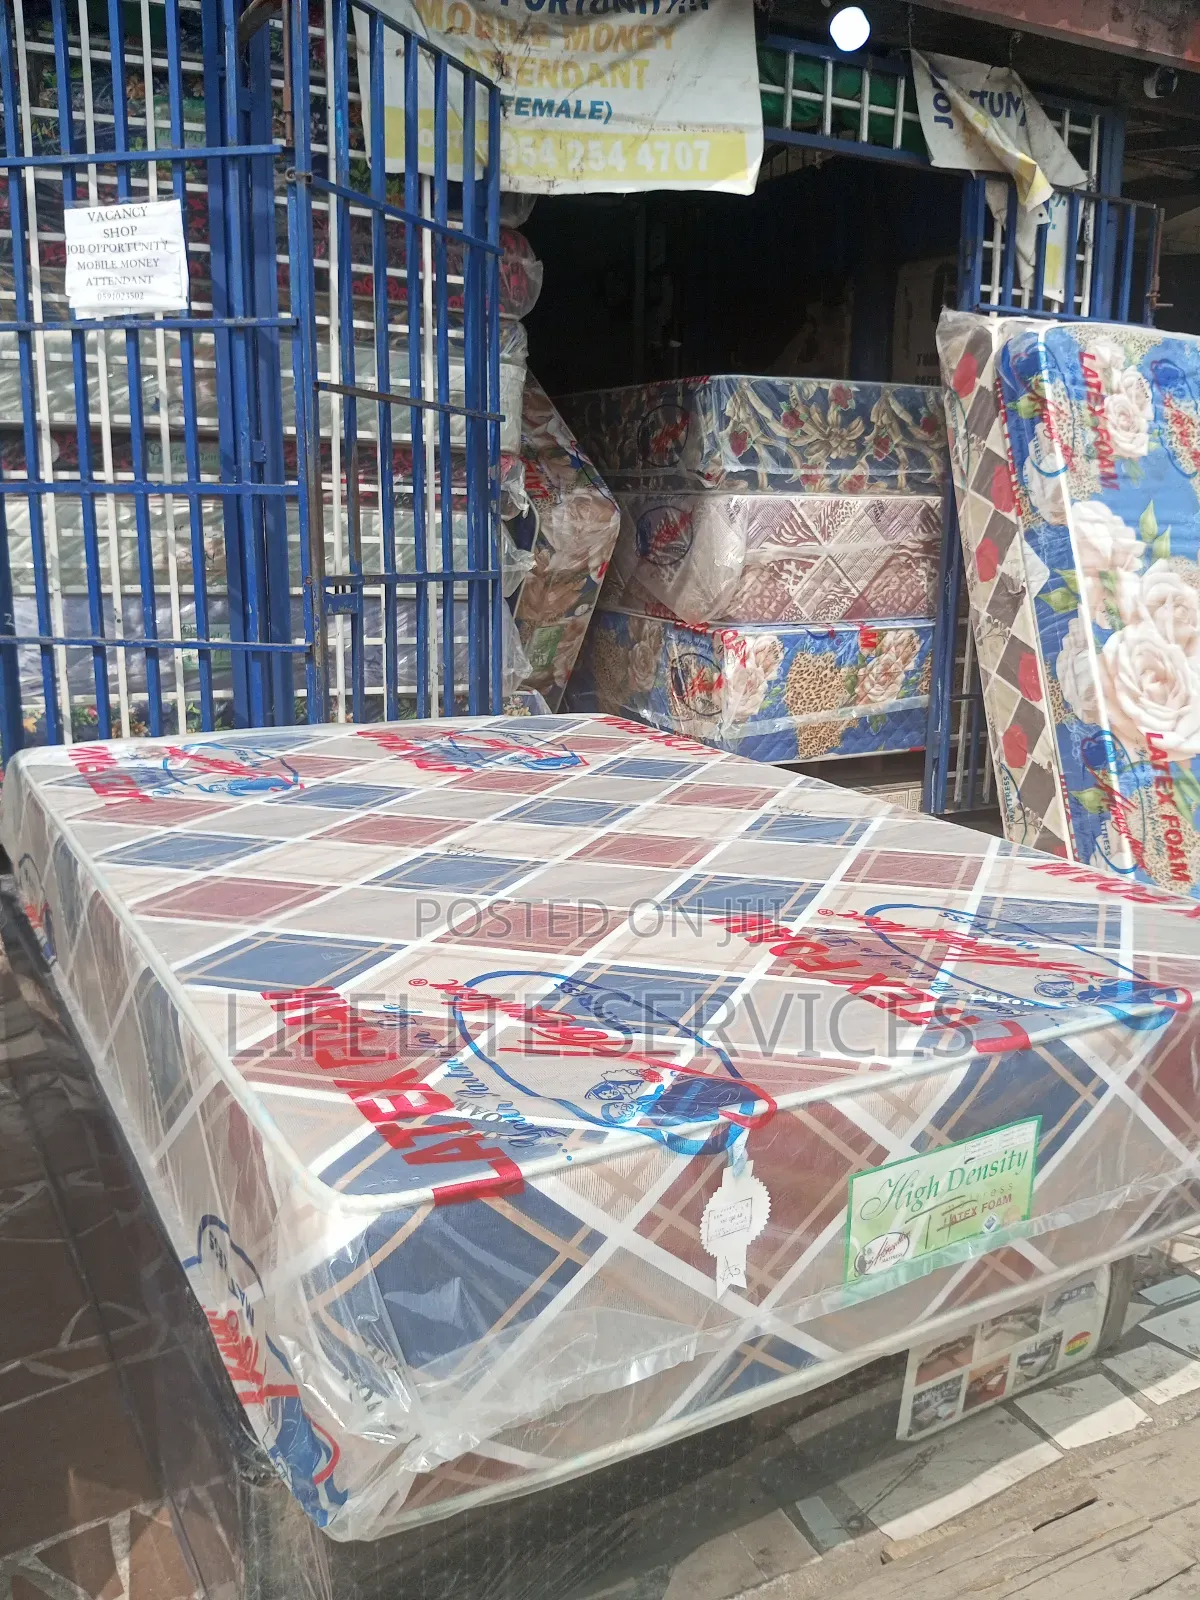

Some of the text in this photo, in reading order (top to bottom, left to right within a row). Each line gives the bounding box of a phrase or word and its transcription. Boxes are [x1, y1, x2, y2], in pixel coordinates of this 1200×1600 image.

[563, 23, 677, 53] MONEY
[567, 139, 627, 173] 254
[636, 138, 711, 173] 4707
[87, 206, 148, 222] VACANCY
[103, 225, 138, 239] SHOP
[67, 244, 86, 256] JOB
[77, 258, 160, 271] MOBILE MONEY
[86, 275, 154, 287] ATTENDANT
[1092, 427, 1121, 491] FOAM
[1145, 732, 1177, 807] LATEX
[1003, 775, 1017, 824] MATTRESS
[1160, 814, 1191, 882] FOAM
[333, 1067, 525, 1207] LATEX
[859, 1149, 1029, 1221] High Density
[981, 1193, 1013, 1214] FOAM
